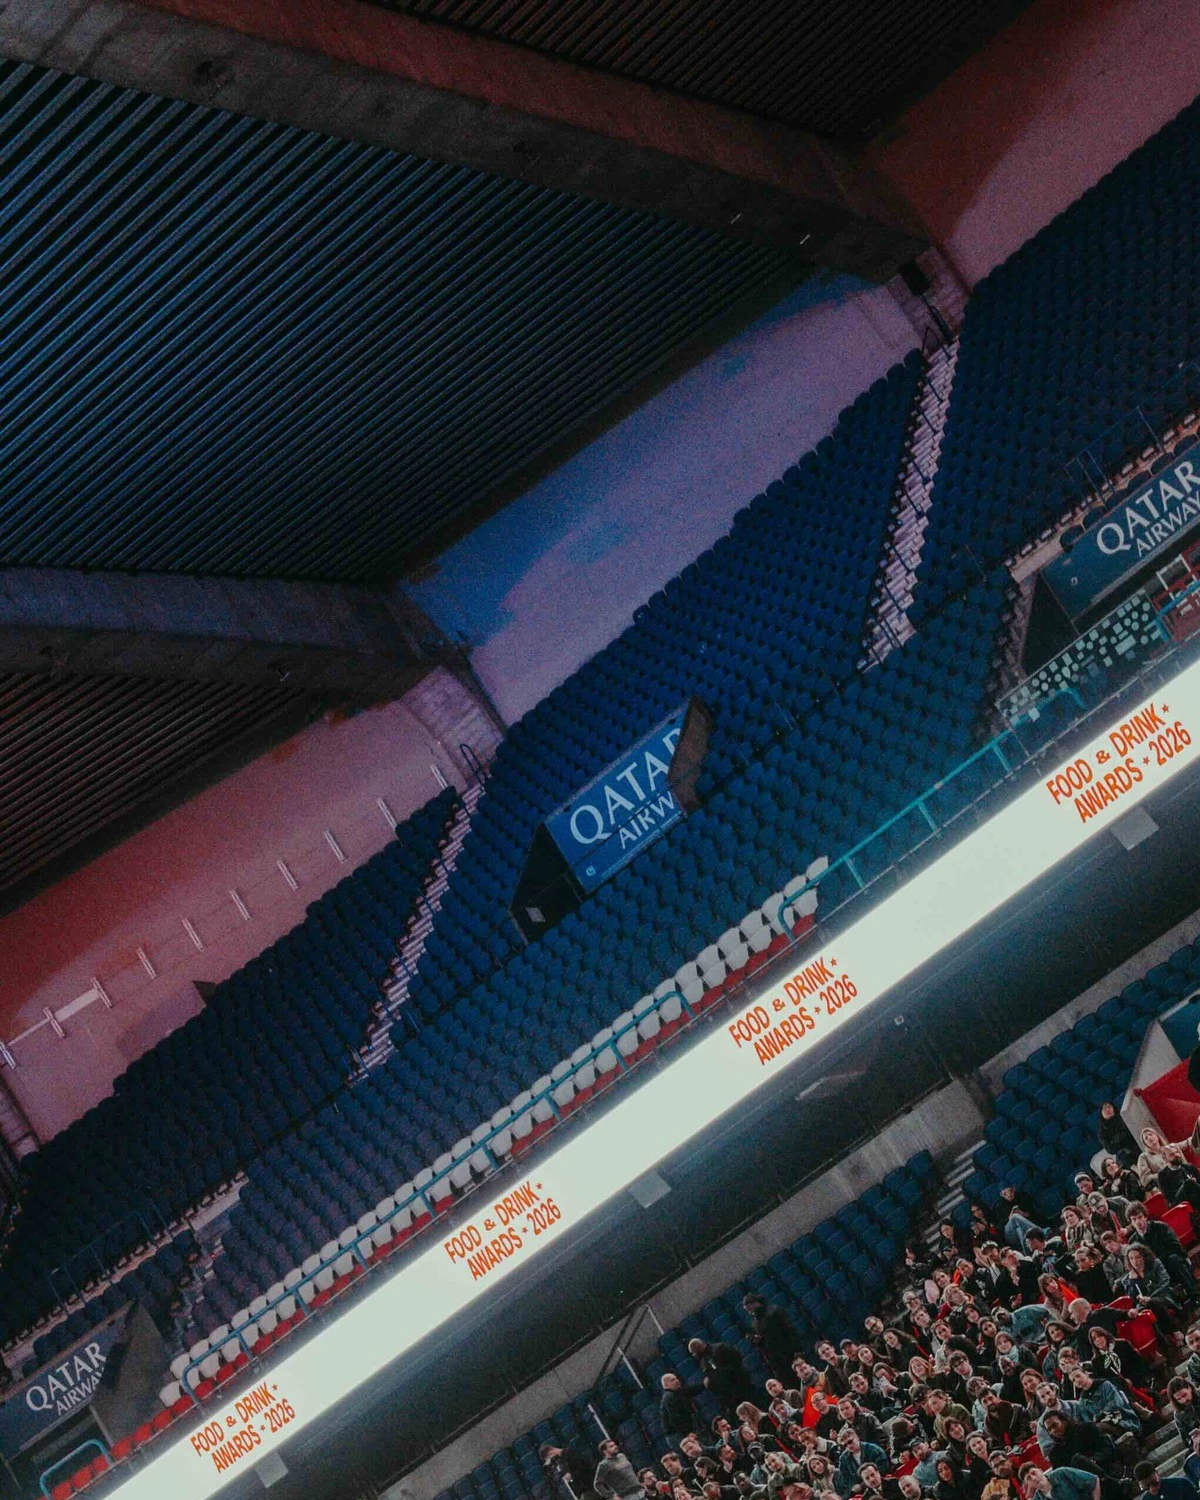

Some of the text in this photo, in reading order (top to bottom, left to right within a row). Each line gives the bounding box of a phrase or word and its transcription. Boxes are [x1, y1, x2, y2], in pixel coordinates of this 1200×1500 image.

[1046, 703, 1166, 803] FOOD & DRINK
[1073, 720, 1192, 823] AWARDS 2026
[618, 790, 675, 850] AIRW
[728, 957, 835, 1046] FOOD & DRINK
[753, 973, 858, 1064] AWARDS 2026
[443, 1181, 539, 1260] FOOD & DRINK
[467, 1197, 562, 1280] AWARDS 2026
[26, 1342, 107, 1411] QATAR
[56, 1367, 105, 1416] AIRWA
[190, 1381, 274, 1454] FOOD & DRINK
[211, 1398, 296, 1471] AWARDS 2026
